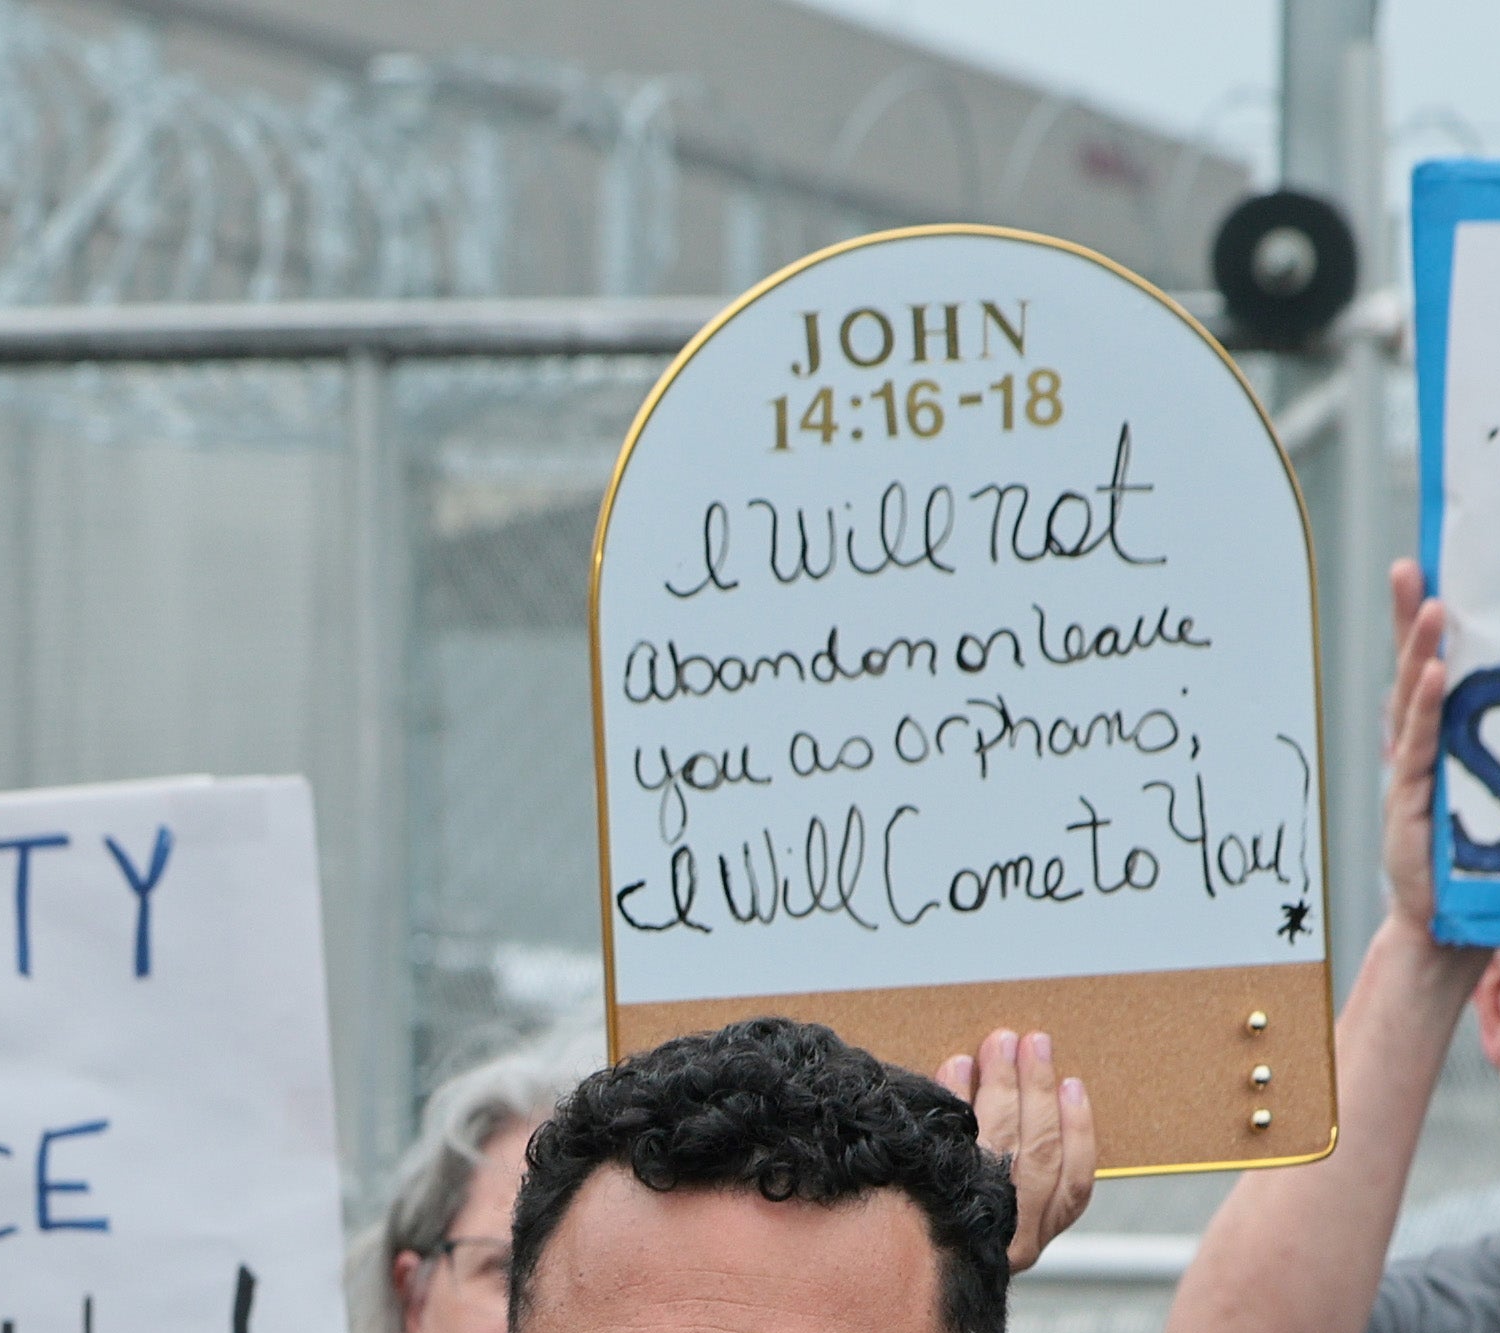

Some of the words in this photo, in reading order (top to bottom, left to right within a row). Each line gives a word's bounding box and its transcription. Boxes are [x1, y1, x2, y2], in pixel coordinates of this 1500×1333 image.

[790, 300, 1030, 379] JOHN
[767, 367, 1065, 453] 14:16-18
[634, 742, 772, 844] you
[790, 731, 874, 776] as
[1066, 795, 1159, 893] to
